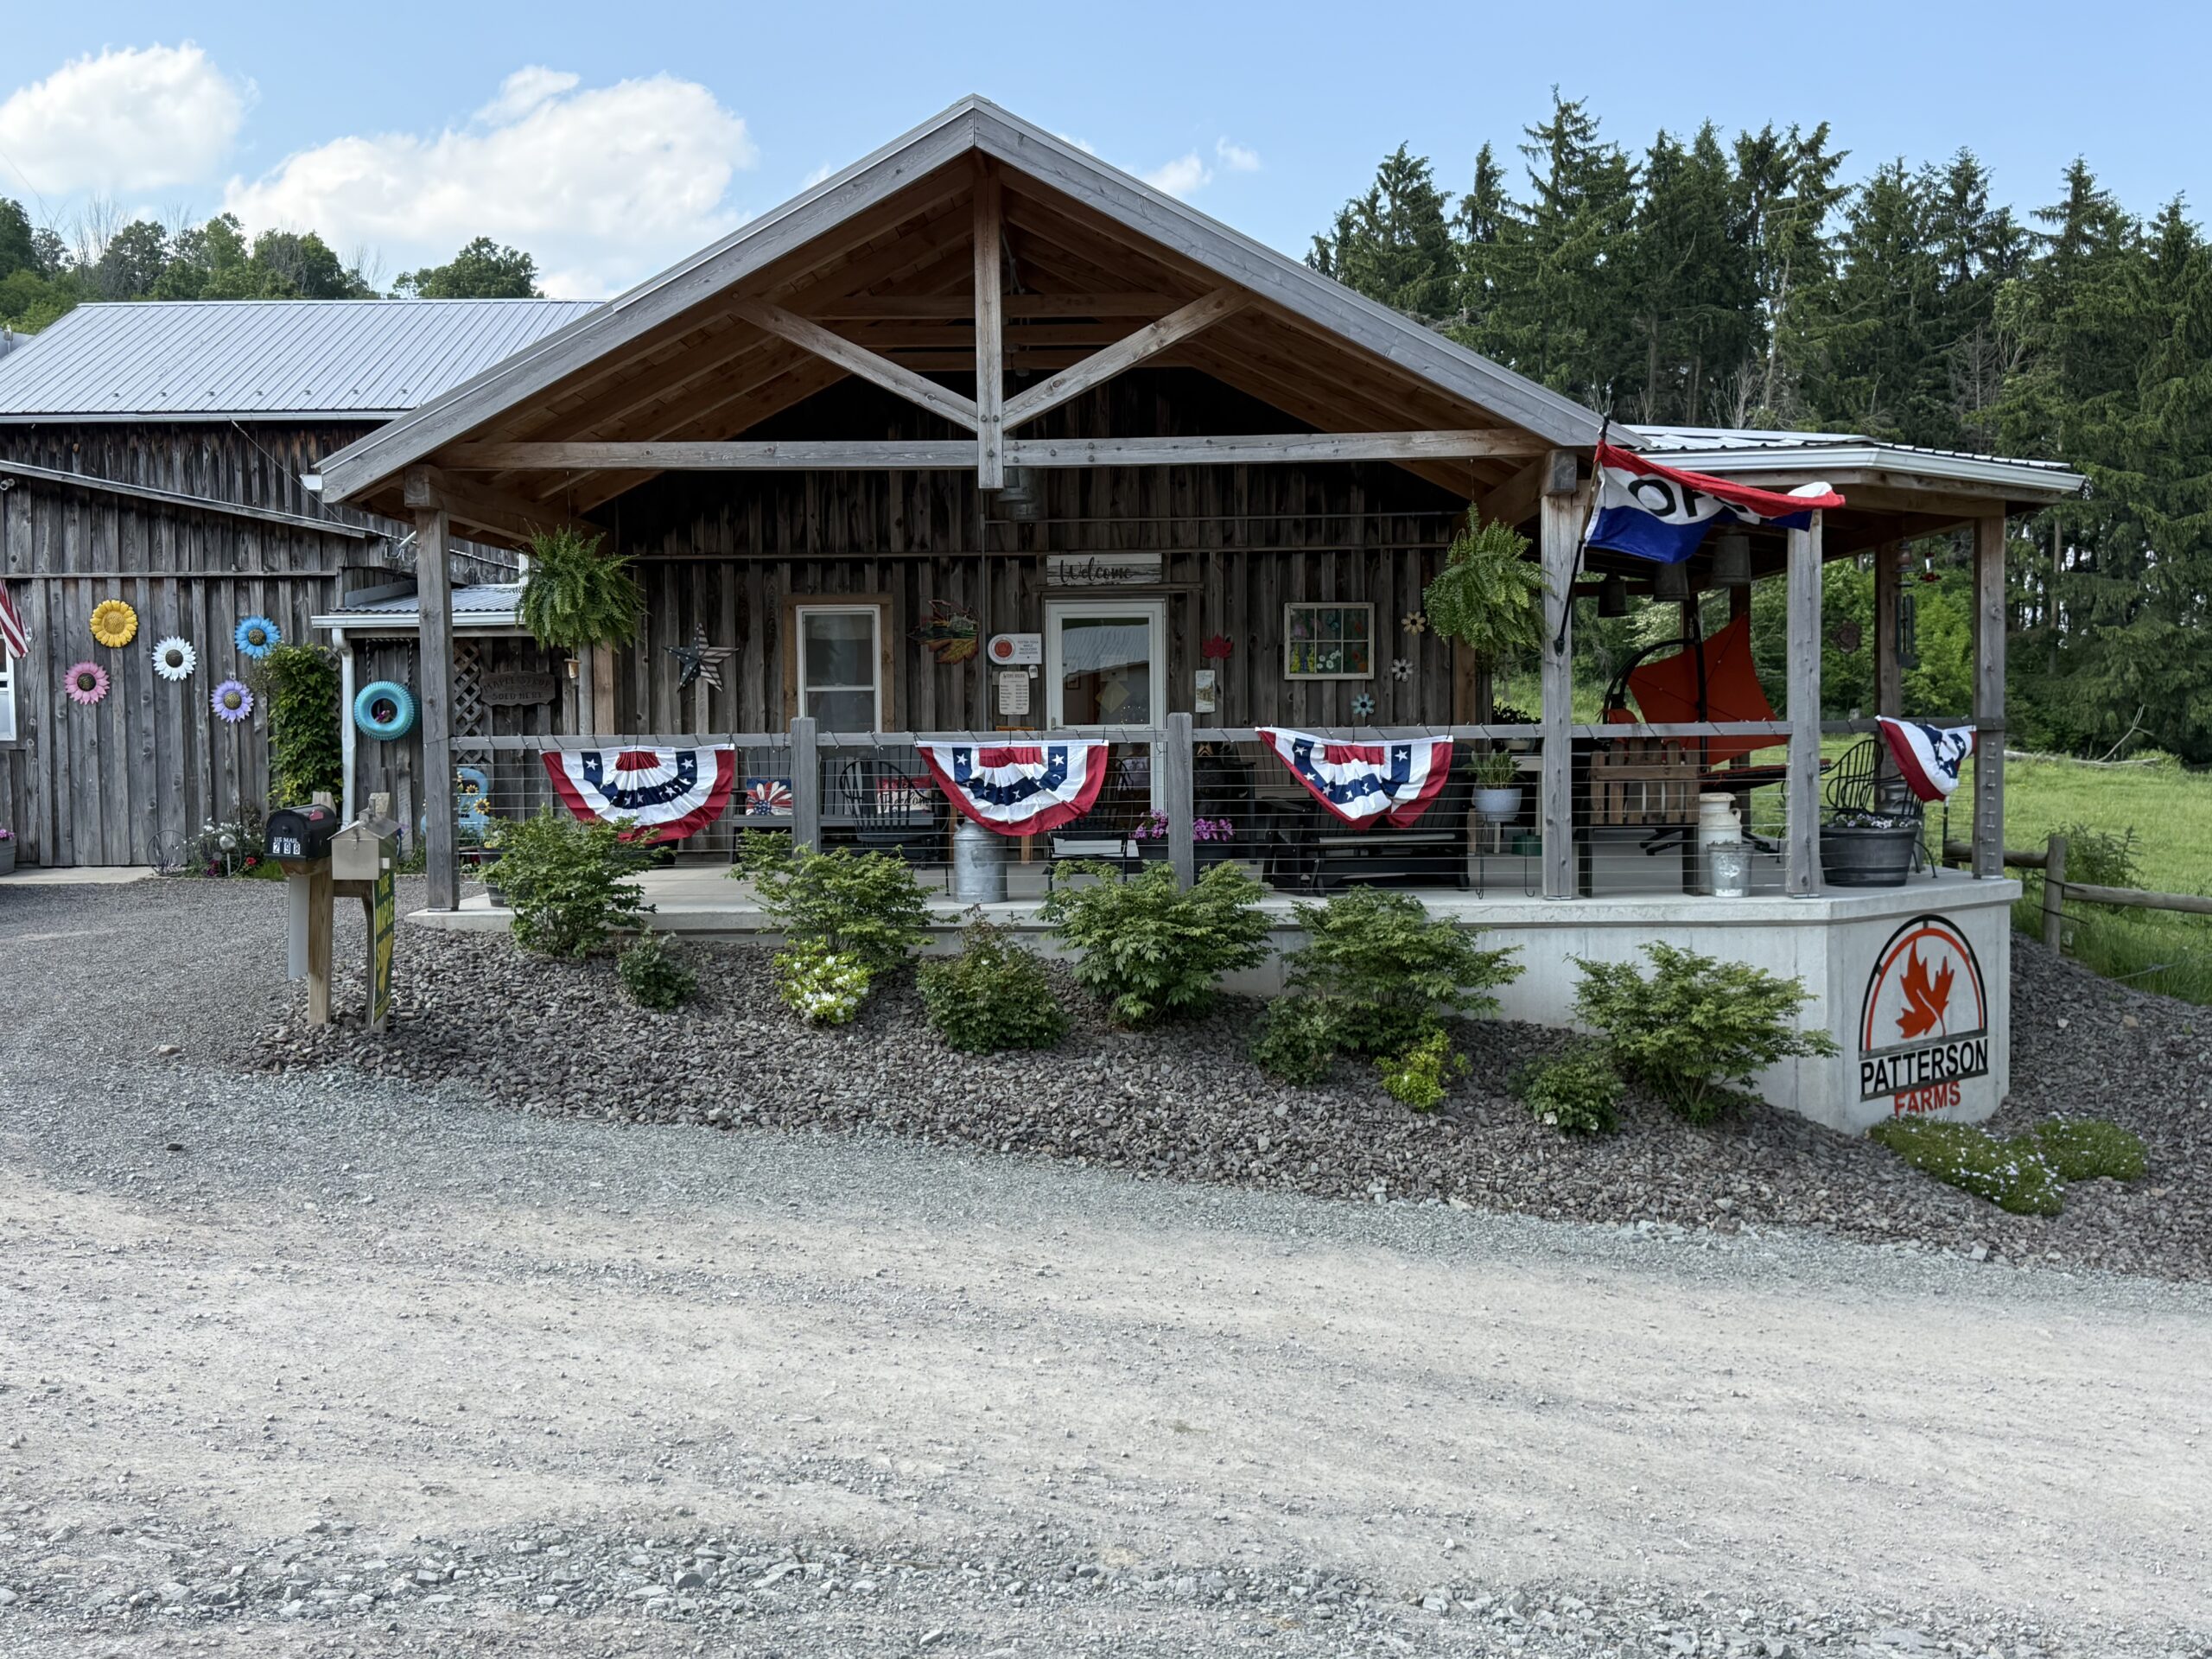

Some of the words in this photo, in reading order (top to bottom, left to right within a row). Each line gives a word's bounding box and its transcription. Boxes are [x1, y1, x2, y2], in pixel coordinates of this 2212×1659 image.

[1059, 556, 1135, 583] Welcome
[482, 676, 515, 692] MAPLE
[492, 691, 517, 701] SOLD
[273, 842, 301, 855] 298
[1860, 1039, 1988, 1096] PATTERSON
[1894, 1080, 1961, 1120] FARMS
